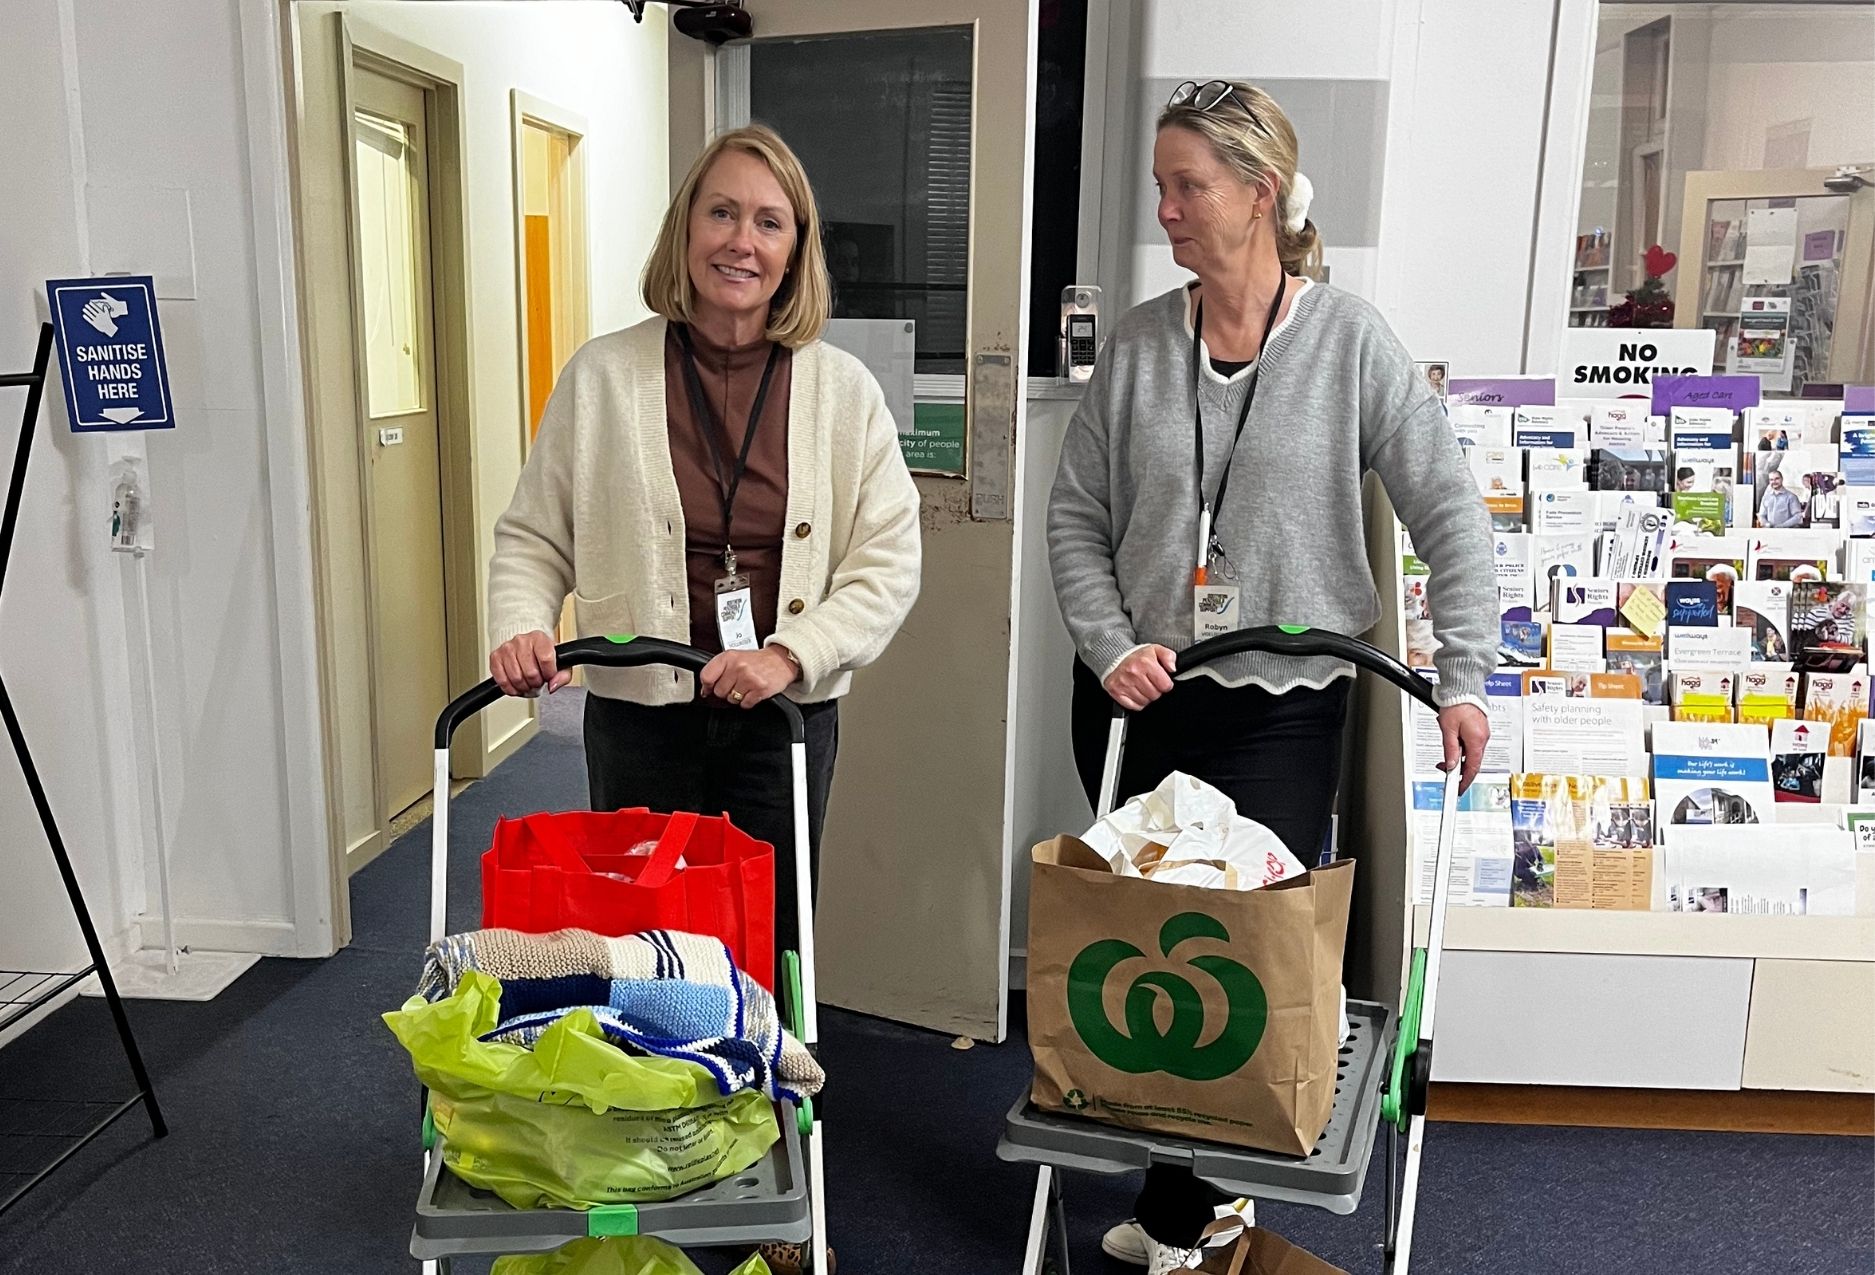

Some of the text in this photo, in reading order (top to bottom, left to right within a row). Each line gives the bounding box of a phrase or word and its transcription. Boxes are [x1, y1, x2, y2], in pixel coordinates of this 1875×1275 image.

[77, 344, 147, 362] SANITISE
[1619, 344, 1658, 362] NO
[88, 364, 142, 380] HANDS
[98, 383, 139, 399] HERE
[1457, 391, 1504, 403] Seniors
[1683, 390, 1733, 402] Aged Care
[899, 440, 960, 449] city of people
[1674, 648, 1711, 656] Evergreen
[1532, 703, 1602, 715] Safety planning
[1532, 716, 1612, 726] with older people
[1863, 833, 1871, 841] of
[657, 1145, 667, 1153] Do
[607, 1185, 621, 1193] This
